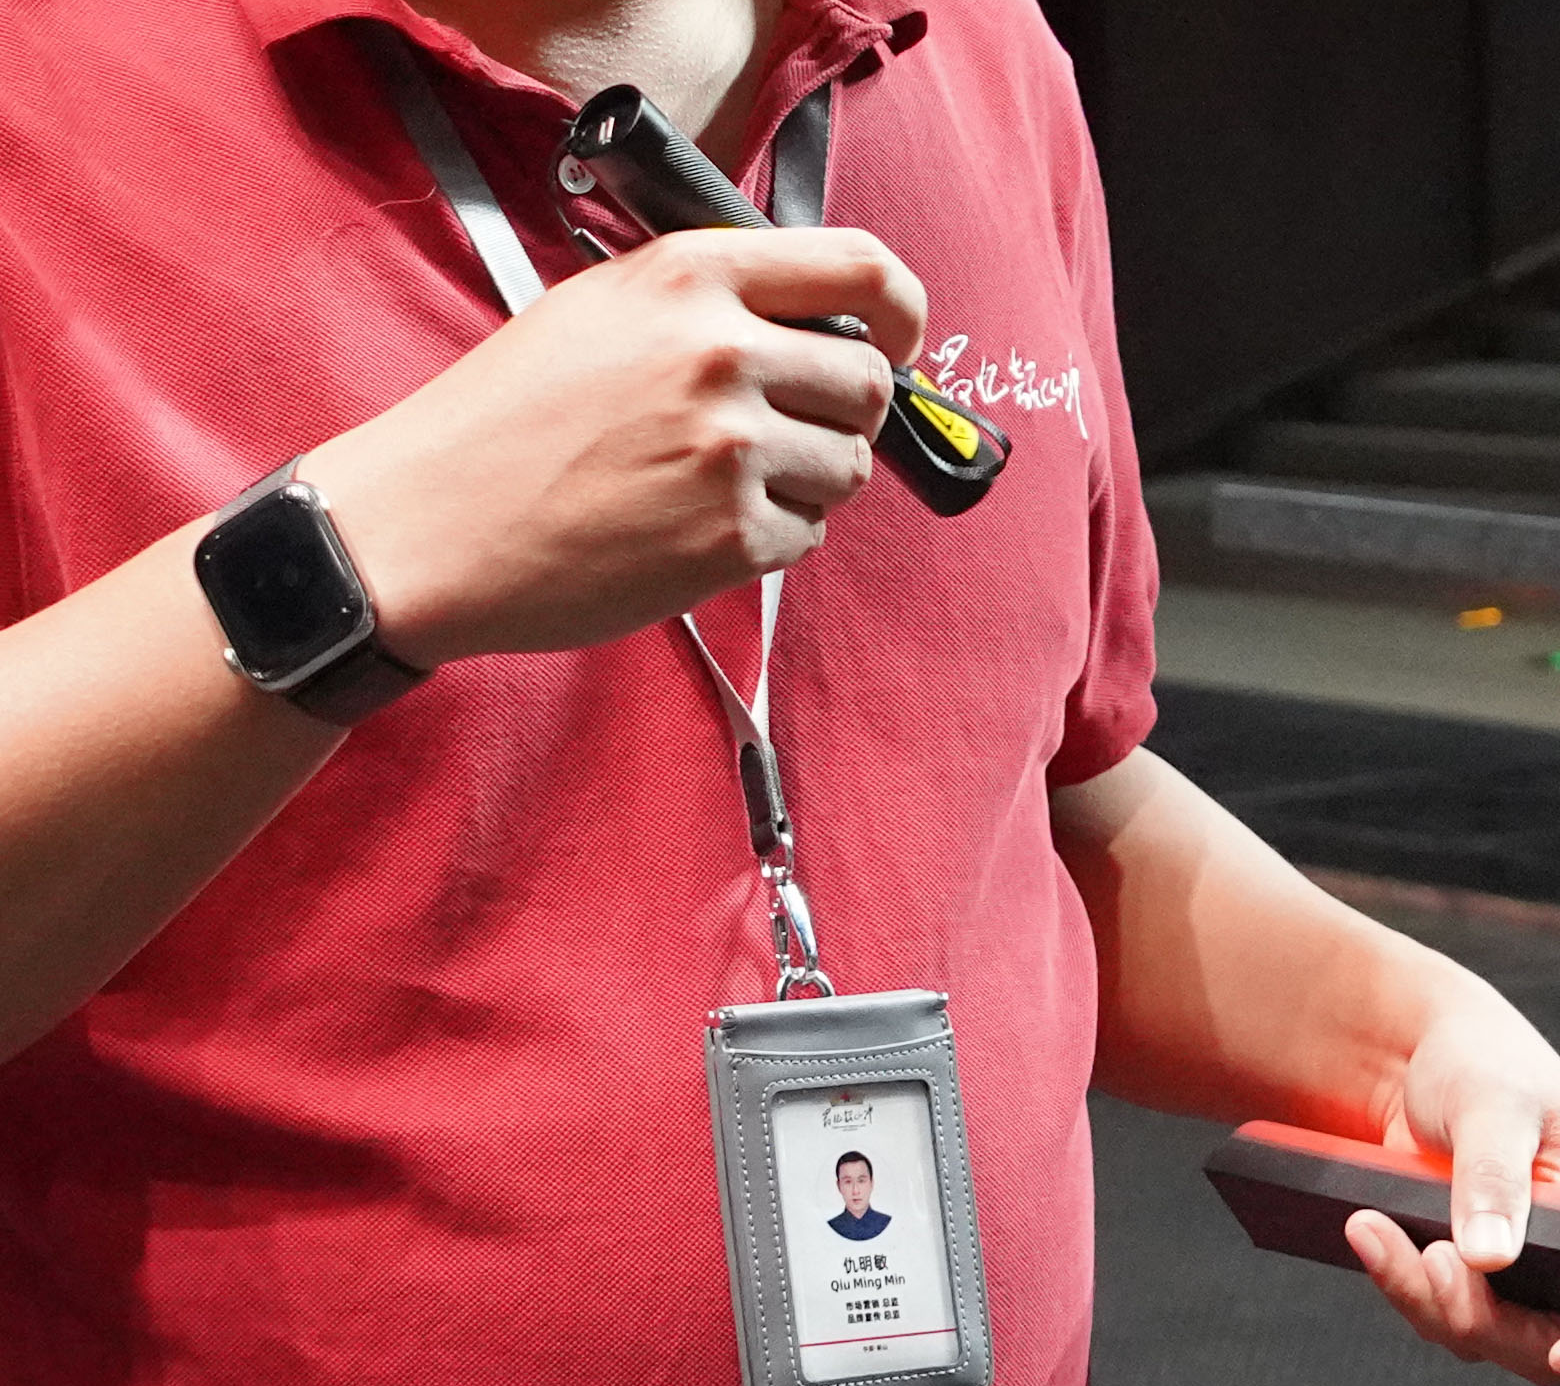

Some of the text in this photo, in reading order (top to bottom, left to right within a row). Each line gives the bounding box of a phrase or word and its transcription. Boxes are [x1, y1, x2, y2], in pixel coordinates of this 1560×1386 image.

[843, 1254, 888, 1274] 仇明敏
[830, 1273, 906, 1293] Qiu Ming Min
